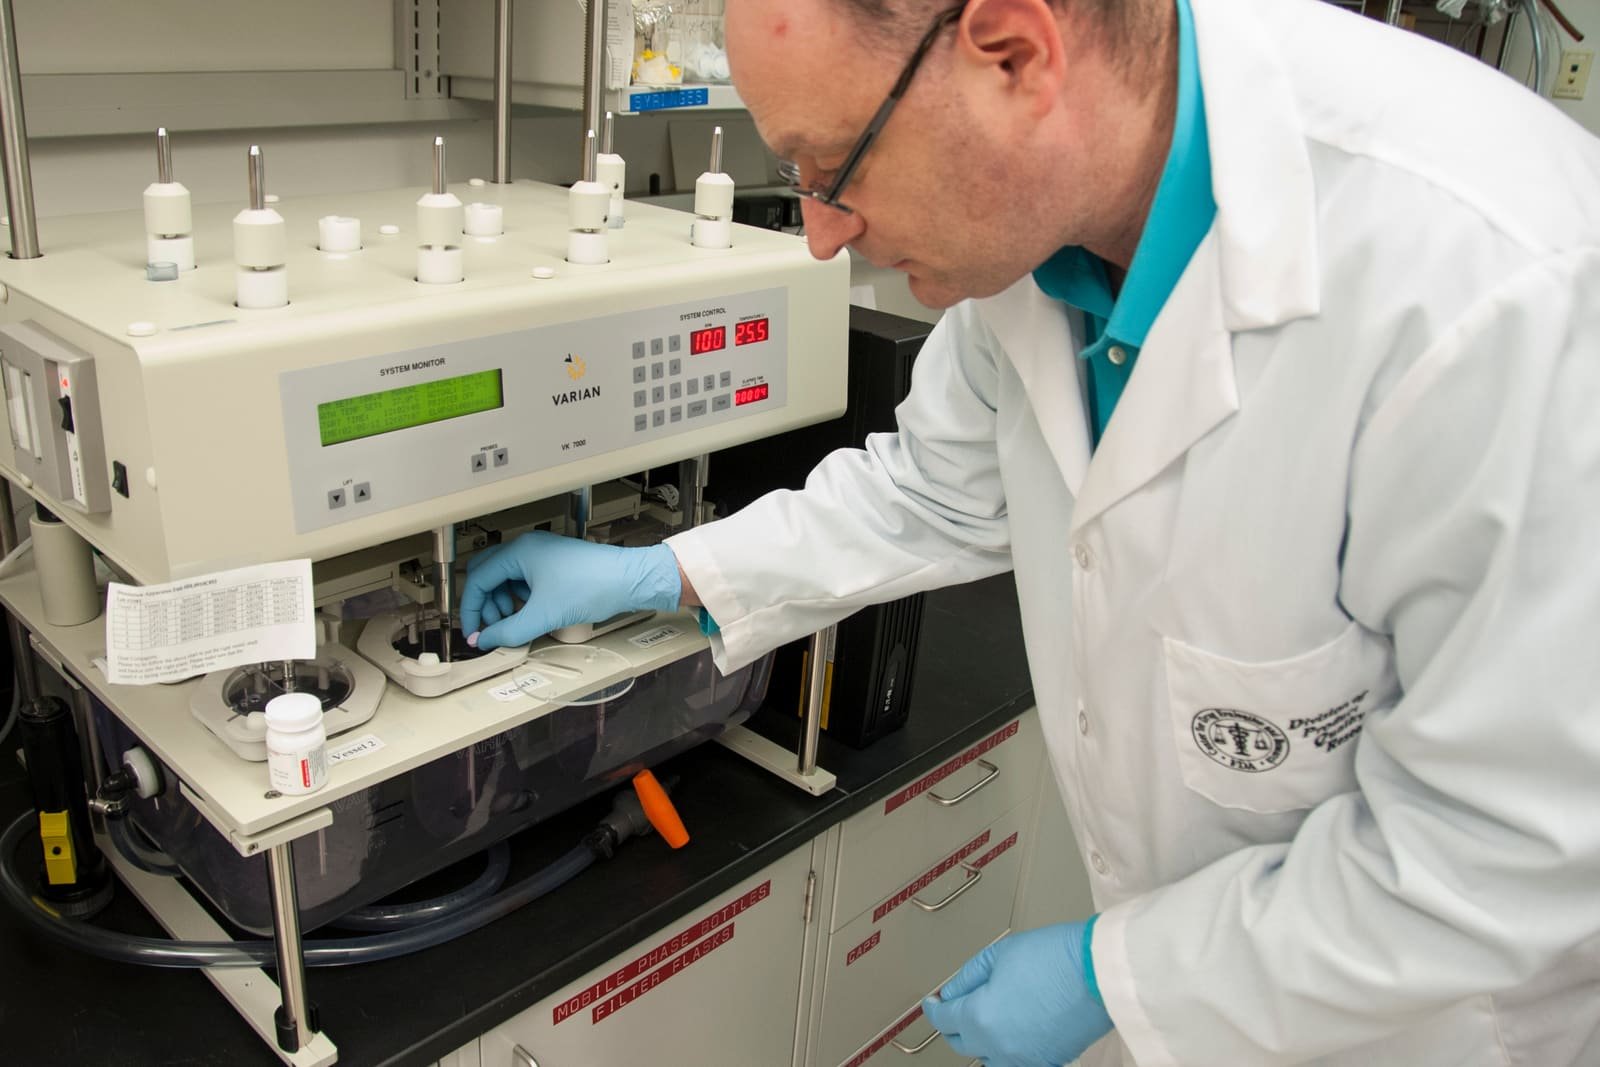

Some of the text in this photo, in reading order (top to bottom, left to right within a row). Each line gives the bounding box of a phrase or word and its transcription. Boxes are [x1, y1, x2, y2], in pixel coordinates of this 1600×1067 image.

[634, 89, 703, 110] SYRIGES
[680, 307, 727, 321] SYSTEM CONTROL
[695, 329, 723, 351] 100
[380, 358, 446, 377] SYSTEM MONITOR
[552, 385, 601, 406] VARIAN
[561, 439, 587, 451] VK 7000
[499, 681, 531, 697] Vessel
[1289, 702, 1349, 730] Division
[332, 740, 376, 760] Vessel 2
[903, 723, 1017, 802] AUTOSAMPLER VIALS
[1230, 759, 1258, 771] FDA
[557, 885, 767, 1021] MOBILE PHASE BOTTLES
[596, 929, 731, 1021] FILTER FLASKS
